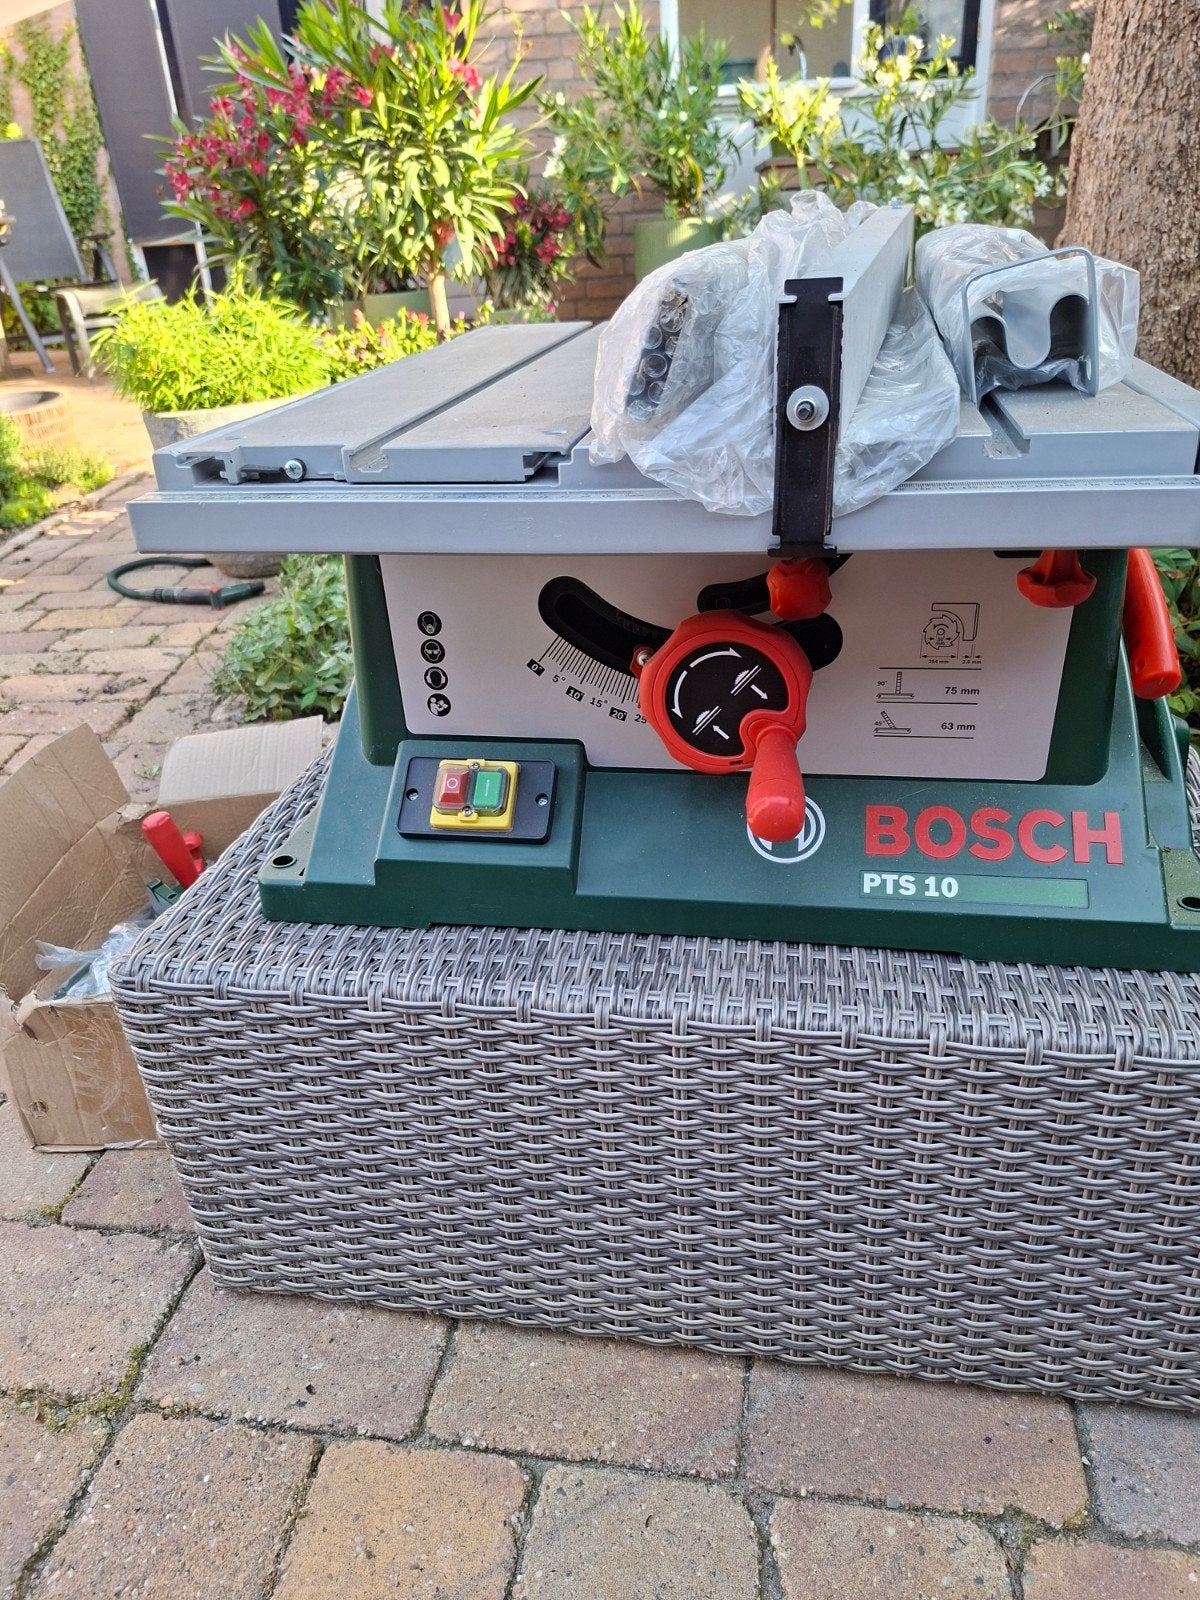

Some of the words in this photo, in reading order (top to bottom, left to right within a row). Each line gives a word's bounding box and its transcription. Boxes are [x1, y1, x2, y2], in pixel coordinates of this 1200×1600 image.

[944, 686, 957, 695] 75
[589, 697, 608, 708] 15°
[941, 722, 953, 731] 63
[865, 805, 1124, 865] BOSCH
[863, 873, 916, 896] PTS
[924, 876, 959, 898] 10
